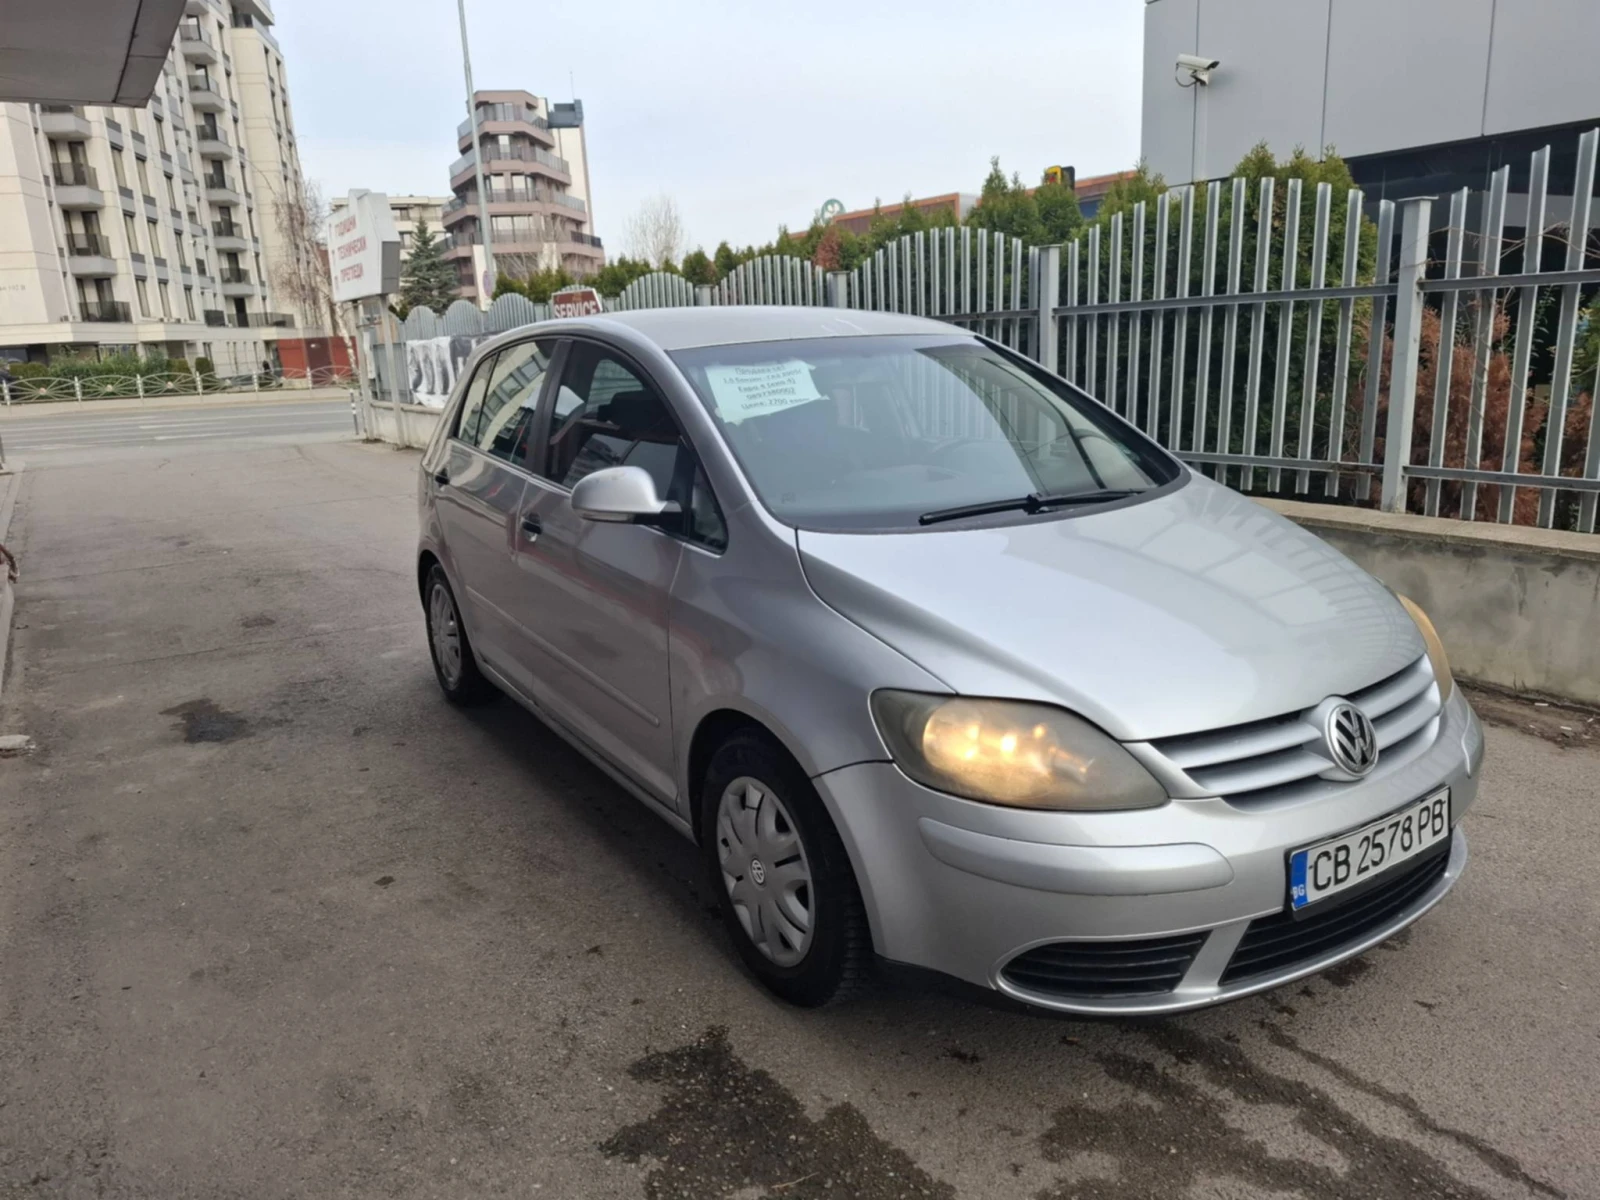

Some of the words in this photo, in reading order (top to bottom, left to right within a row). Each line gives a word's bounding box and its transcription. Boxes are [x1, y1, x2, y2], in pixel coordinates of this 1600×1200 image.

[554, 300, 597, 318] SERVICE
[1313, 844, 1350, 891] CB
[1357, 815, 1414, 876] 2578
[1418, 799, 1445, 845] PB
[1292, 884, 1306, 899] BG
